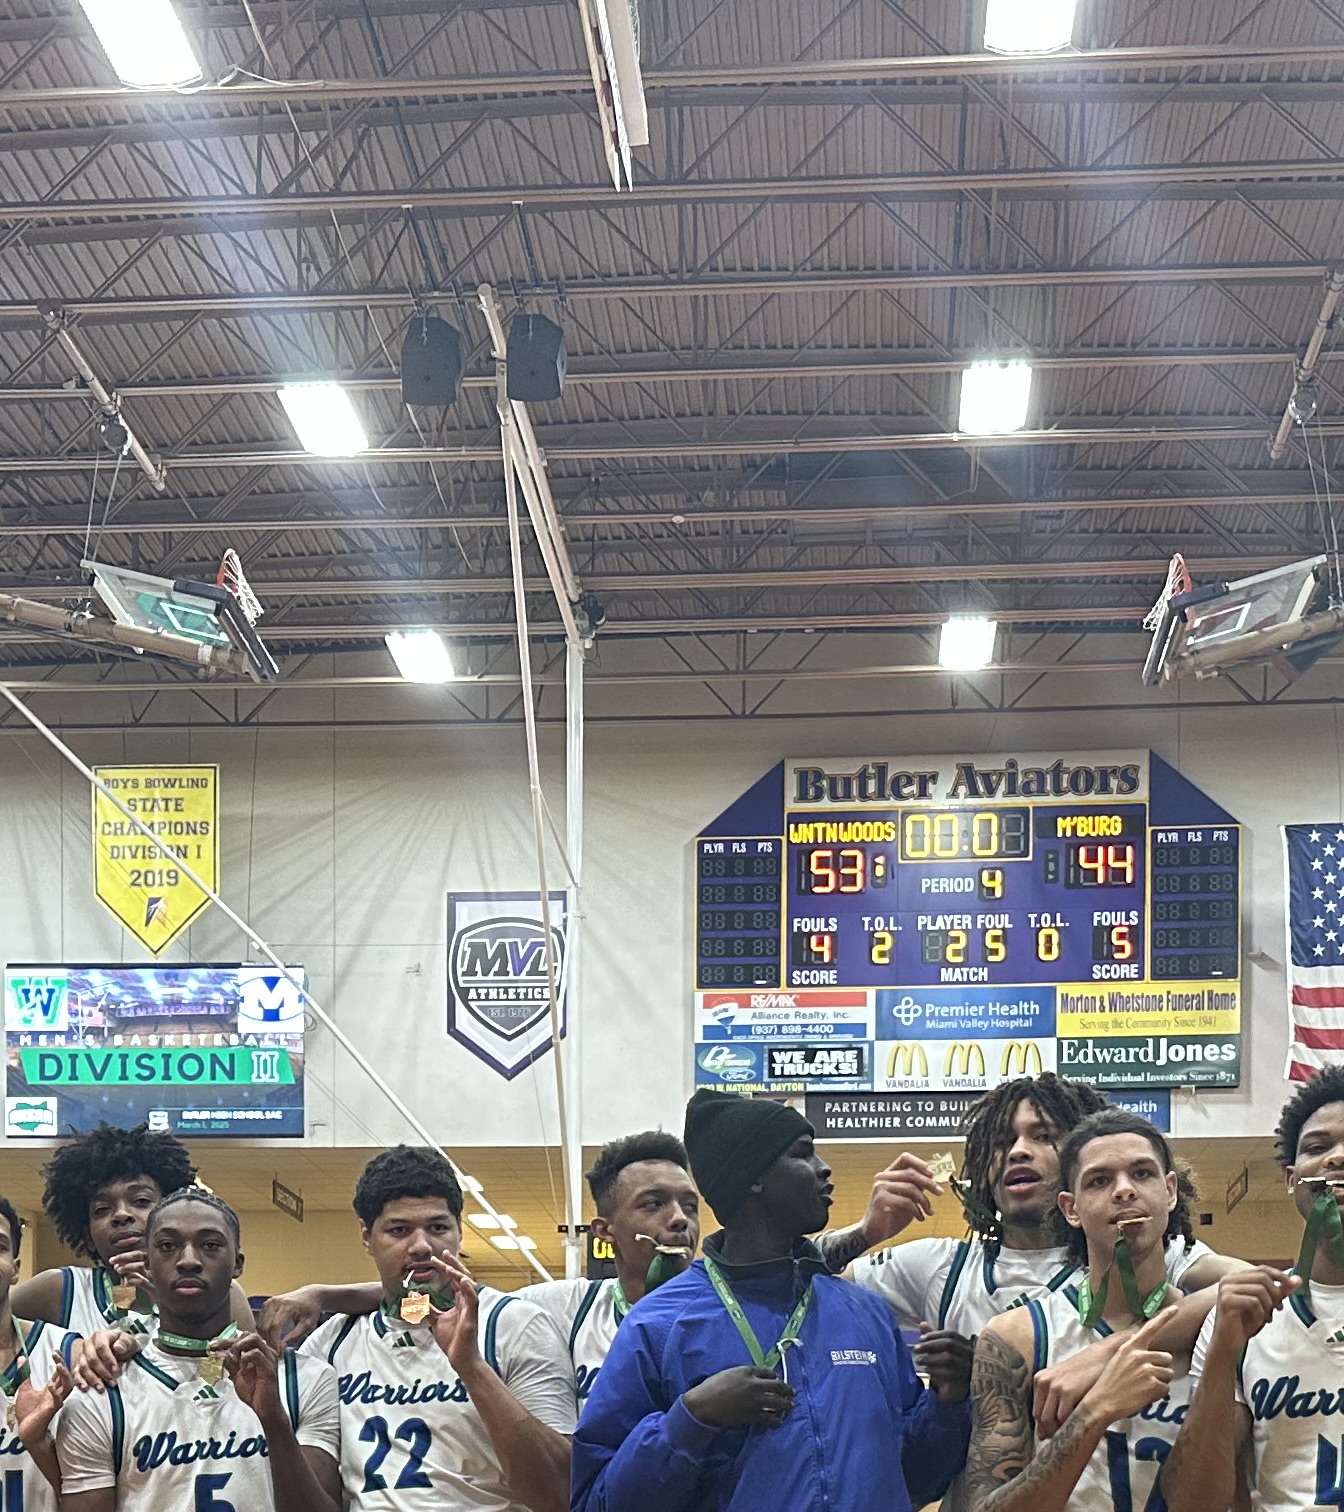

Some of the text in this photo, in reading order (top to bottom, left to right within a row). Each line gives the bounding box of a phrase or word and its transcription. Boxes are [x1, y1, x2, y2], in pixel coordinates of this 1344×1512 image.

[103, 778, 208, 788] BOYS BOWLING
[793, 758, 1140, 803] Butler Aviators
[127, 798, 184, 812] STATE
[789, 822, 896, 844] WNTNWOODS
[1057, 815, 1122, 837] M'BURG
[196, 845, 202, 859] I
[810, 850, 865, 894] 53
[1079, 845, 1134, 884] 44
[130, 869, 179, 887] 2019
[921, 877, 974, 893] PERIOD
[981, 869, 1002, 898] 4
[793, 911, 1139, 931] FOULS PLAYER FOUL T.O.L. FOULS
[810, 935, 831, 963] 4
[792, 969, 838, 985] SCORE
[940, 966, 988, 982] MATCH
[1092, 963, 1139, 980] SCORE
[468, 988, 552, 1000] ATHLETICS
[1060, 989, 1237, 1014] Morton & Whetstone Funeral Home
[751, 1011, 790, 1020] Alliance
[833, 1010, 851, 1019] Inc.
[926, 1001, 1040, 1018] Premier Health
[781, 1025, 834, 1034] 898-4400
[926, 1017, 1033, 1030] Miami Valley Hospital
[19, 1034, 95, 1046] MEN'S
[772, 1050, 857, 1064] WE ARE
[38, 1050, 280, 1083] DIVISION II
[772, 1062, 858, 1075] TRUCKS!
[885, 1080, 930, 1089] VANDALIA
[1098, 1073, 1188, 1083] Individual Investors
[825, 1101, 934, 1113] PARTNERING TO
[826, 1117, 901, 1129] HEALTHIER
[338, 1370, 469, 1405] Warriors
[132, 1430, 269, 1473] Warrior
[358, 1415, 434, 1494] 22
